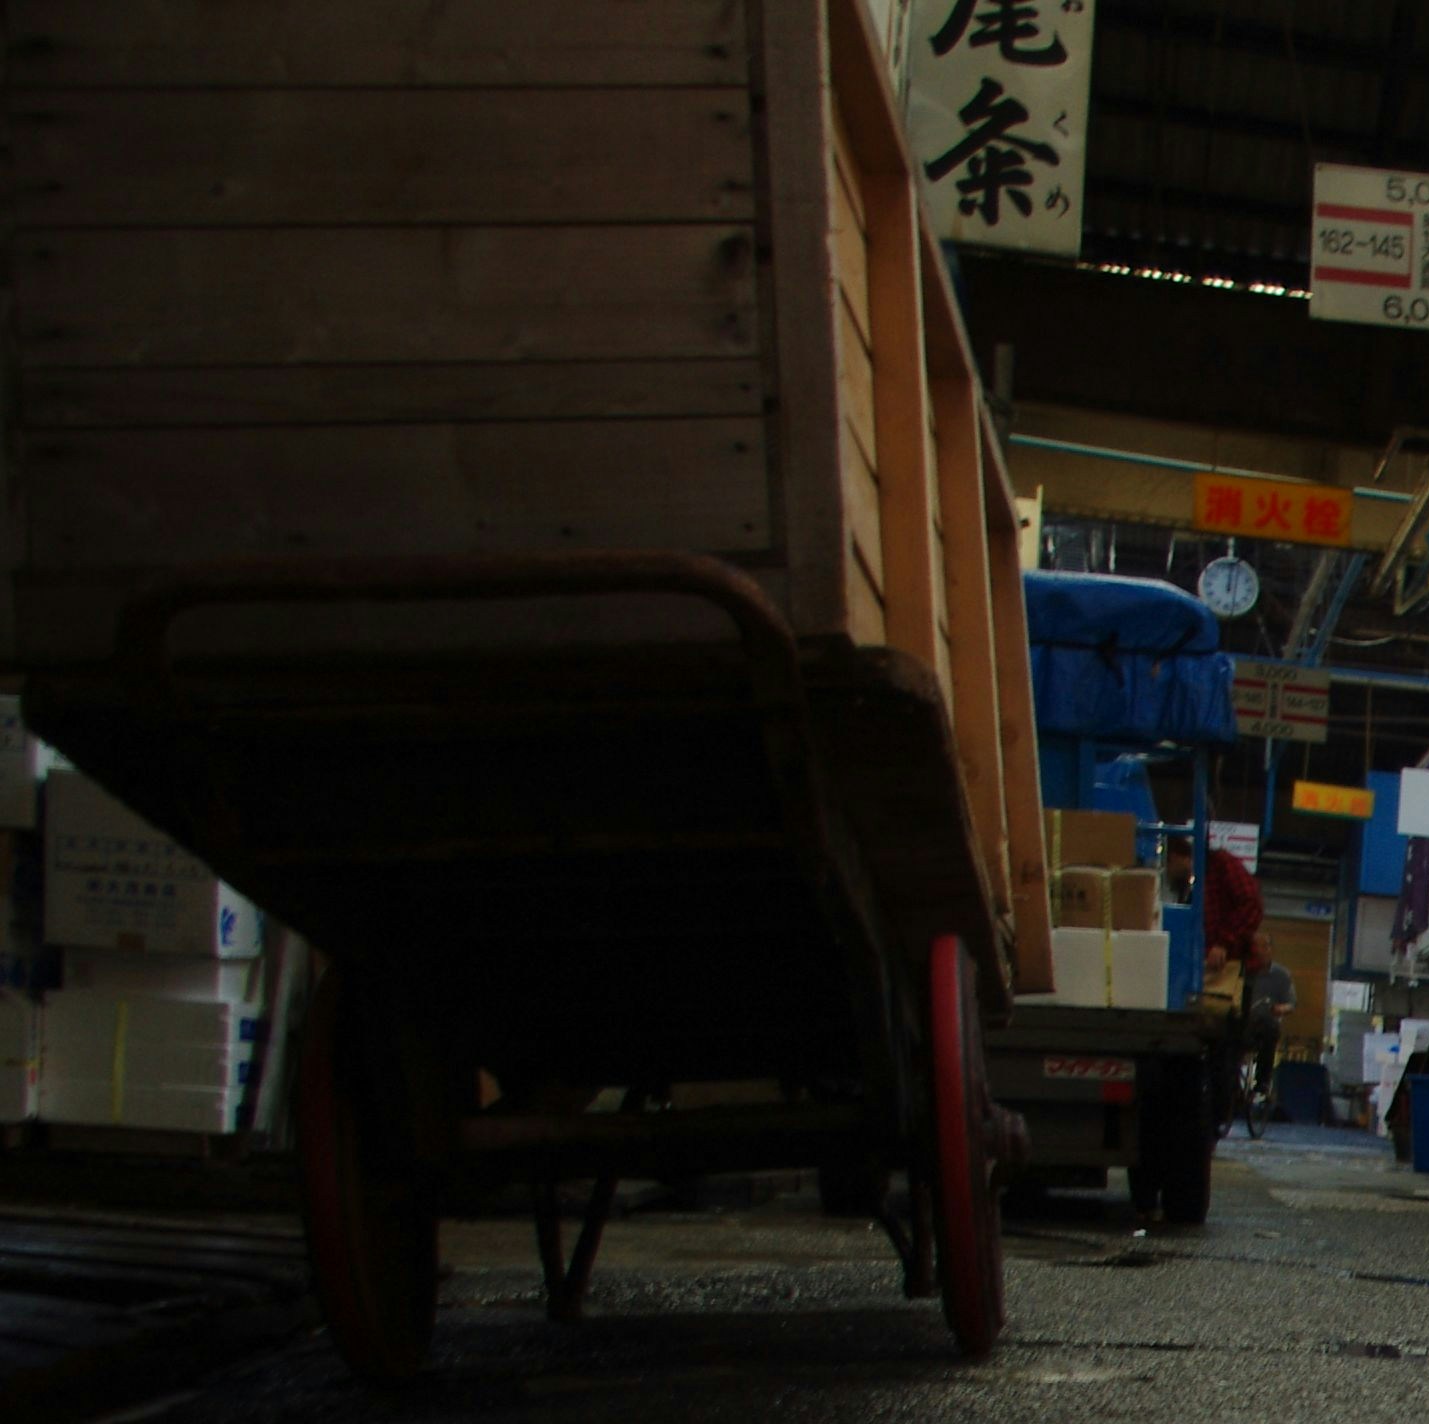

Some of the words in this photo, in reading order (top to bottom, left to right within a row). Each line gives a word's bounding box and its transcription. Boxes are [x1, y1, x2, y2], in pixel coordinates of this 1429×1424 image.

[1318, 229, 1405, 260] 162-145
[1204, 486, 1342, 538] 消火栓
